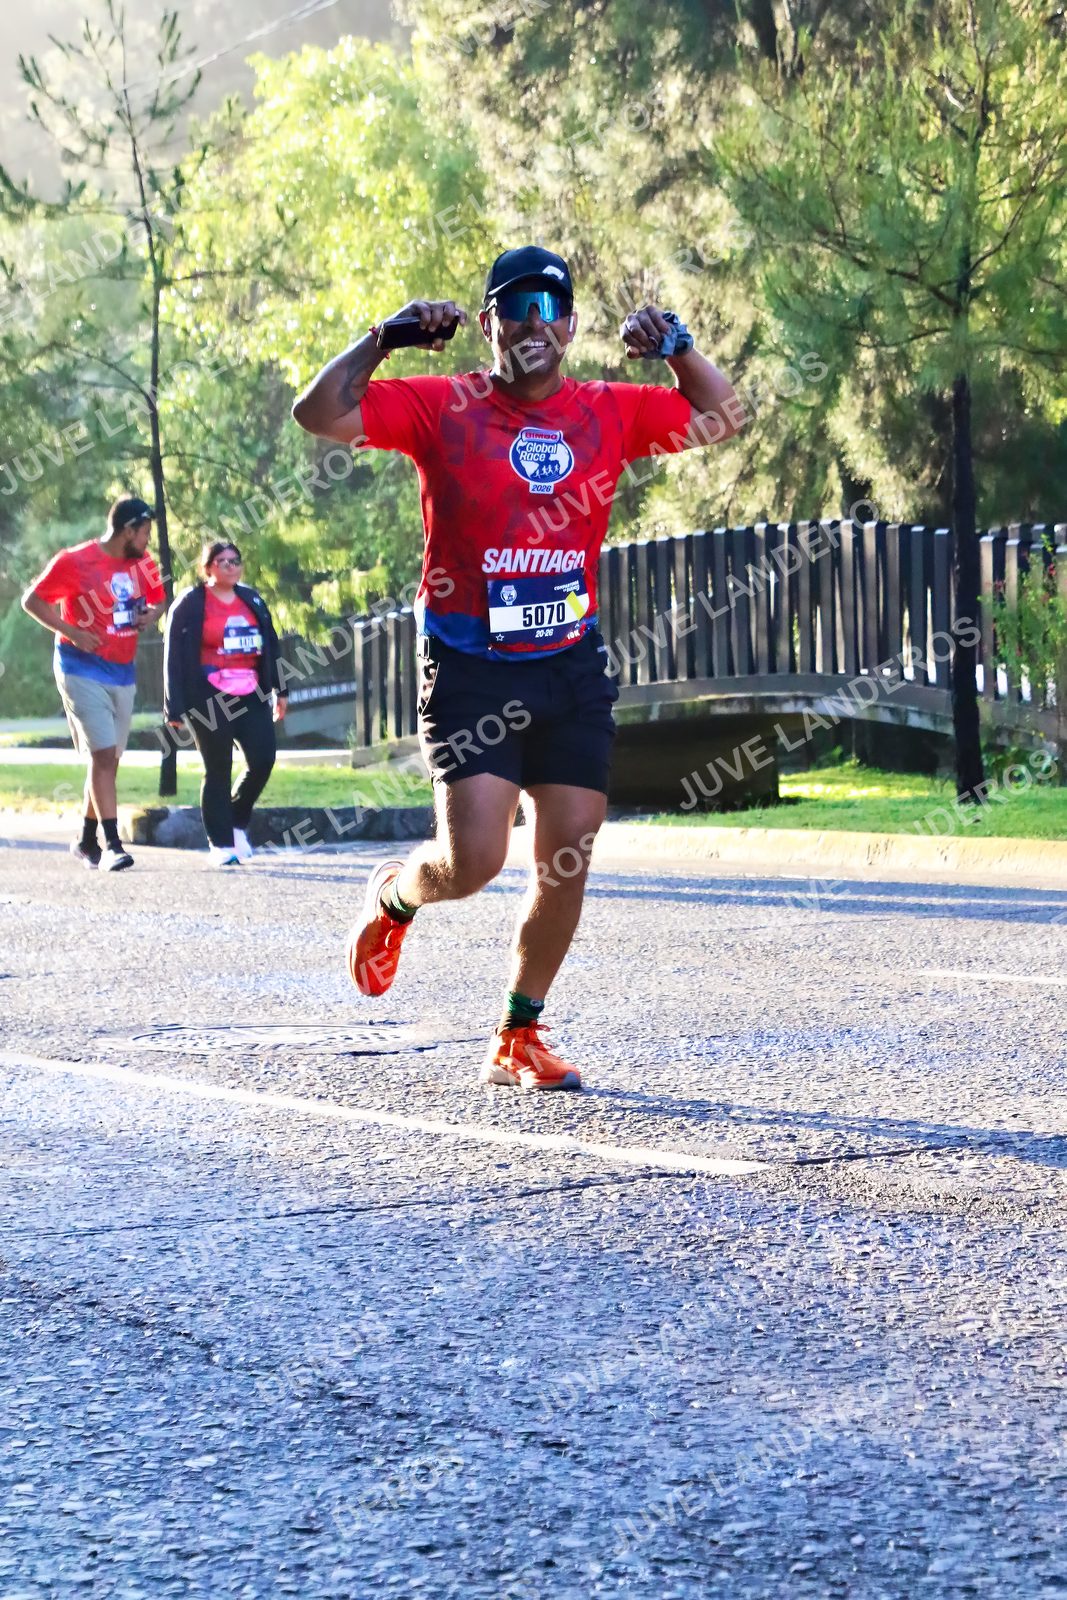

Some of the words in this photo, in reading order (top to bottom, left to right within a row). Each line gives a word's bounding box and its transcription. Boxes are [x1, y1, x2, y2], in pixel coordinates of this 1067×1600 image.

[526, 442, 557, 454] Global
[520, 451, 546, 462] Race
[531, 484, 552, 492] 2026
[481, 548, 585, 573] SANTIAGO
[522, 602, 566, 627] 5070
[535, 628, 554, 638] 20-26
